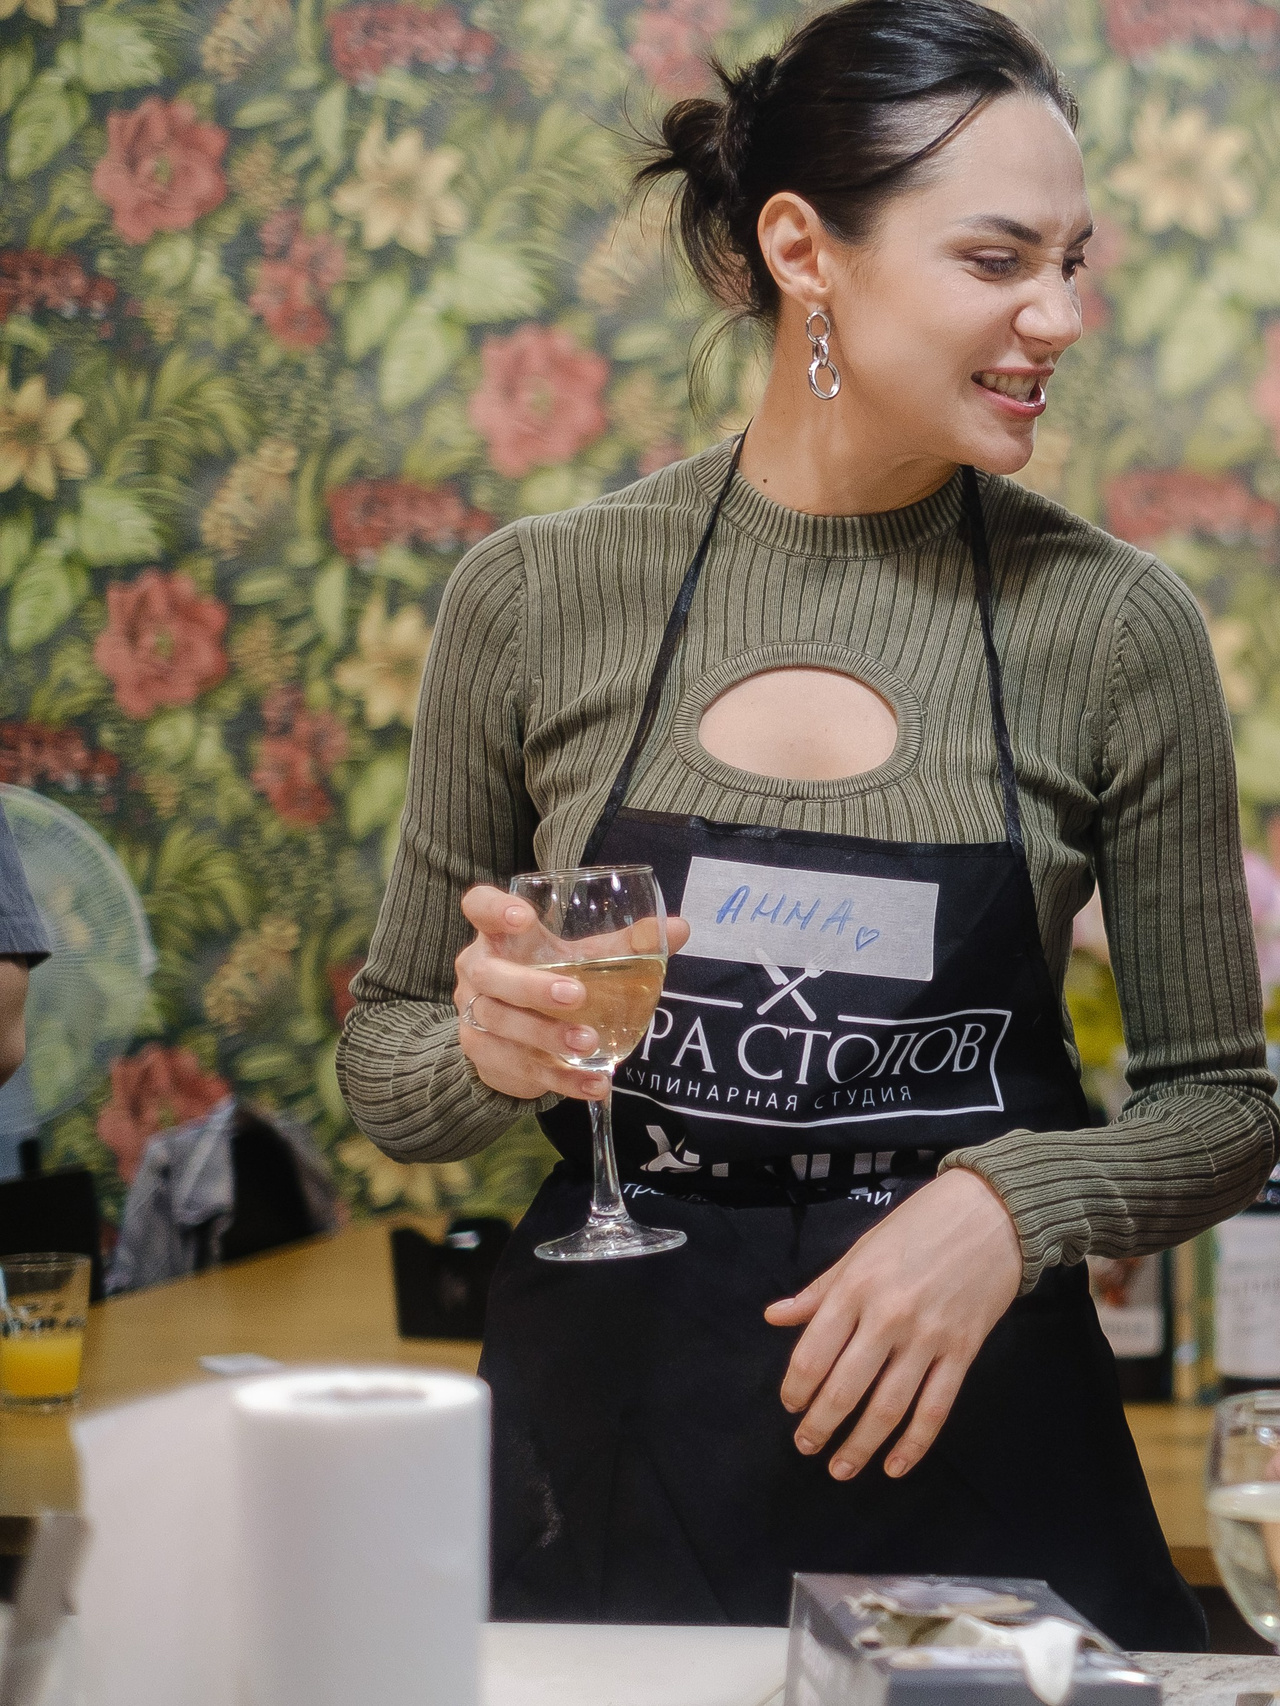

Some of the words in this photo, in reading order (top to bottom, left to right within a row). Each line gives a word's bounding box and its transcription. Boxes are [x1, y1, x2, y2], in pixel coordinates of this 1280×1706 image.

[640, 1007, 717, 1073] РА
[737, 1023, 987, 1084] СТОЛОВ
[625, 1067, 798, 1112] КУЛИНАРНАЯ
[814, 1085, 912, 1110] СТУДИЯ
